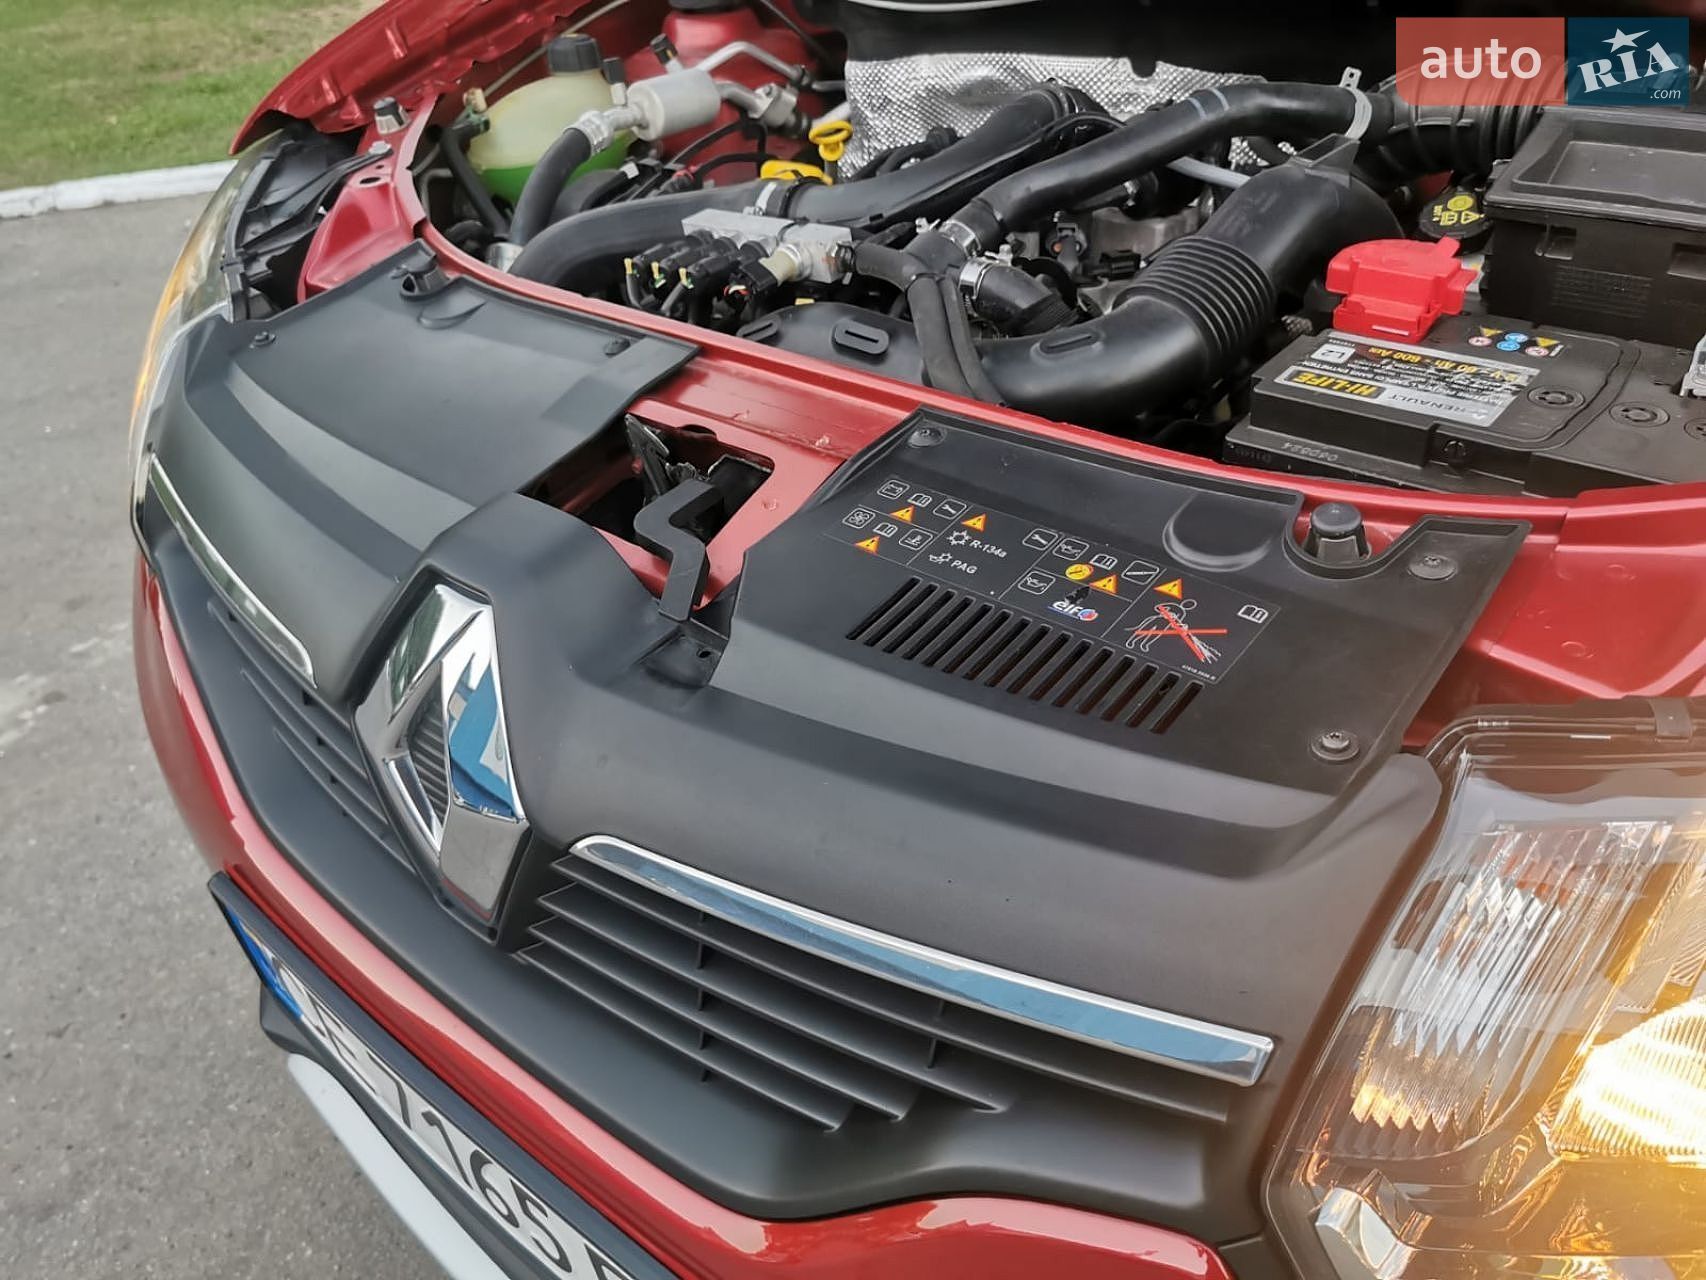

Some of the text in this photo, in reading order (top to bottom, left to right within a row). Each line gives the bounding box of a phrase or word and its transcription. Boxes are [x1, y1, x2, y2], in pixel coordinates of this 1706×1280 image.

[1320, 349, 1345, 360] L2
[1291, 371, 1378, 397] HI-LIFE
[1388, 394, 1467, 413] RENAULT
[950, 559, 979, 575] PAG
